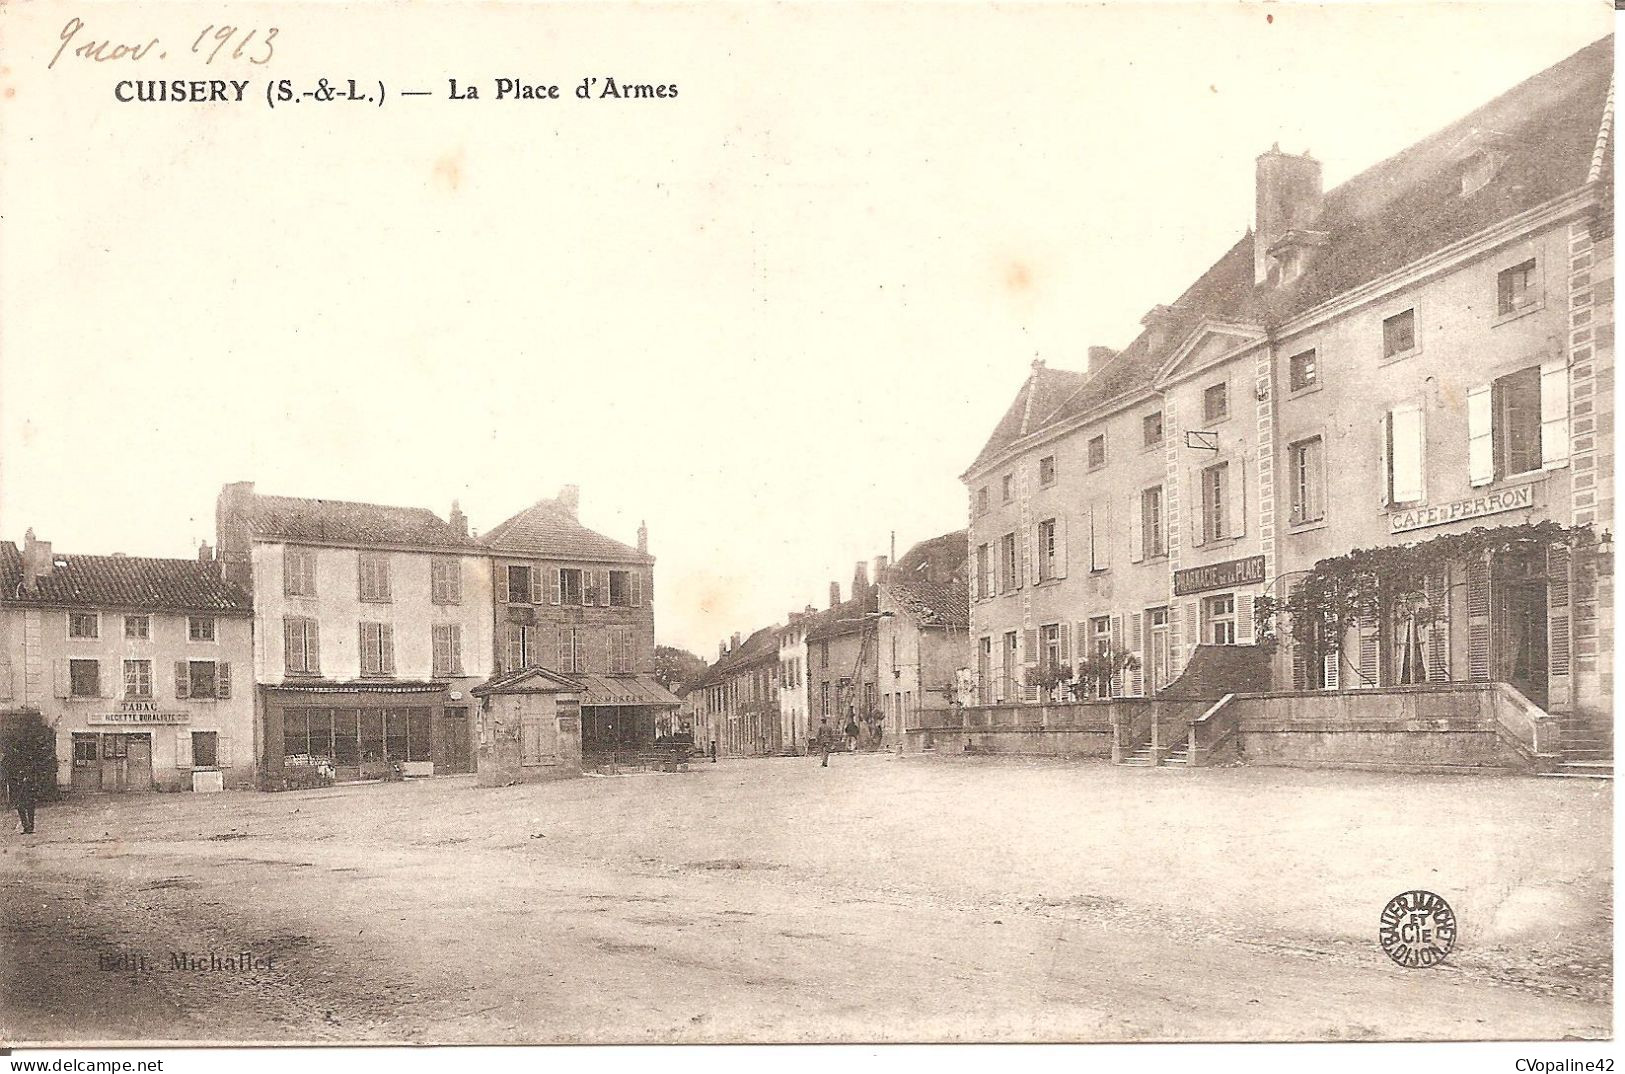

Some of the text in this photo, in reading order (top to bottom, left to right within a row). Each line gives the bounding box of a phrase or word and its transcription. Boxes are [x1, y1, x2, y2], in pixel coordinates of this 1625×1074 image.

[48, 17, 279, 69] 9 nov. 1913
[1449, 487, 1529, 519] PERRON
[1235, 558, 1264, 581] PLACE
[121, 702, 158, 712] TABAC
